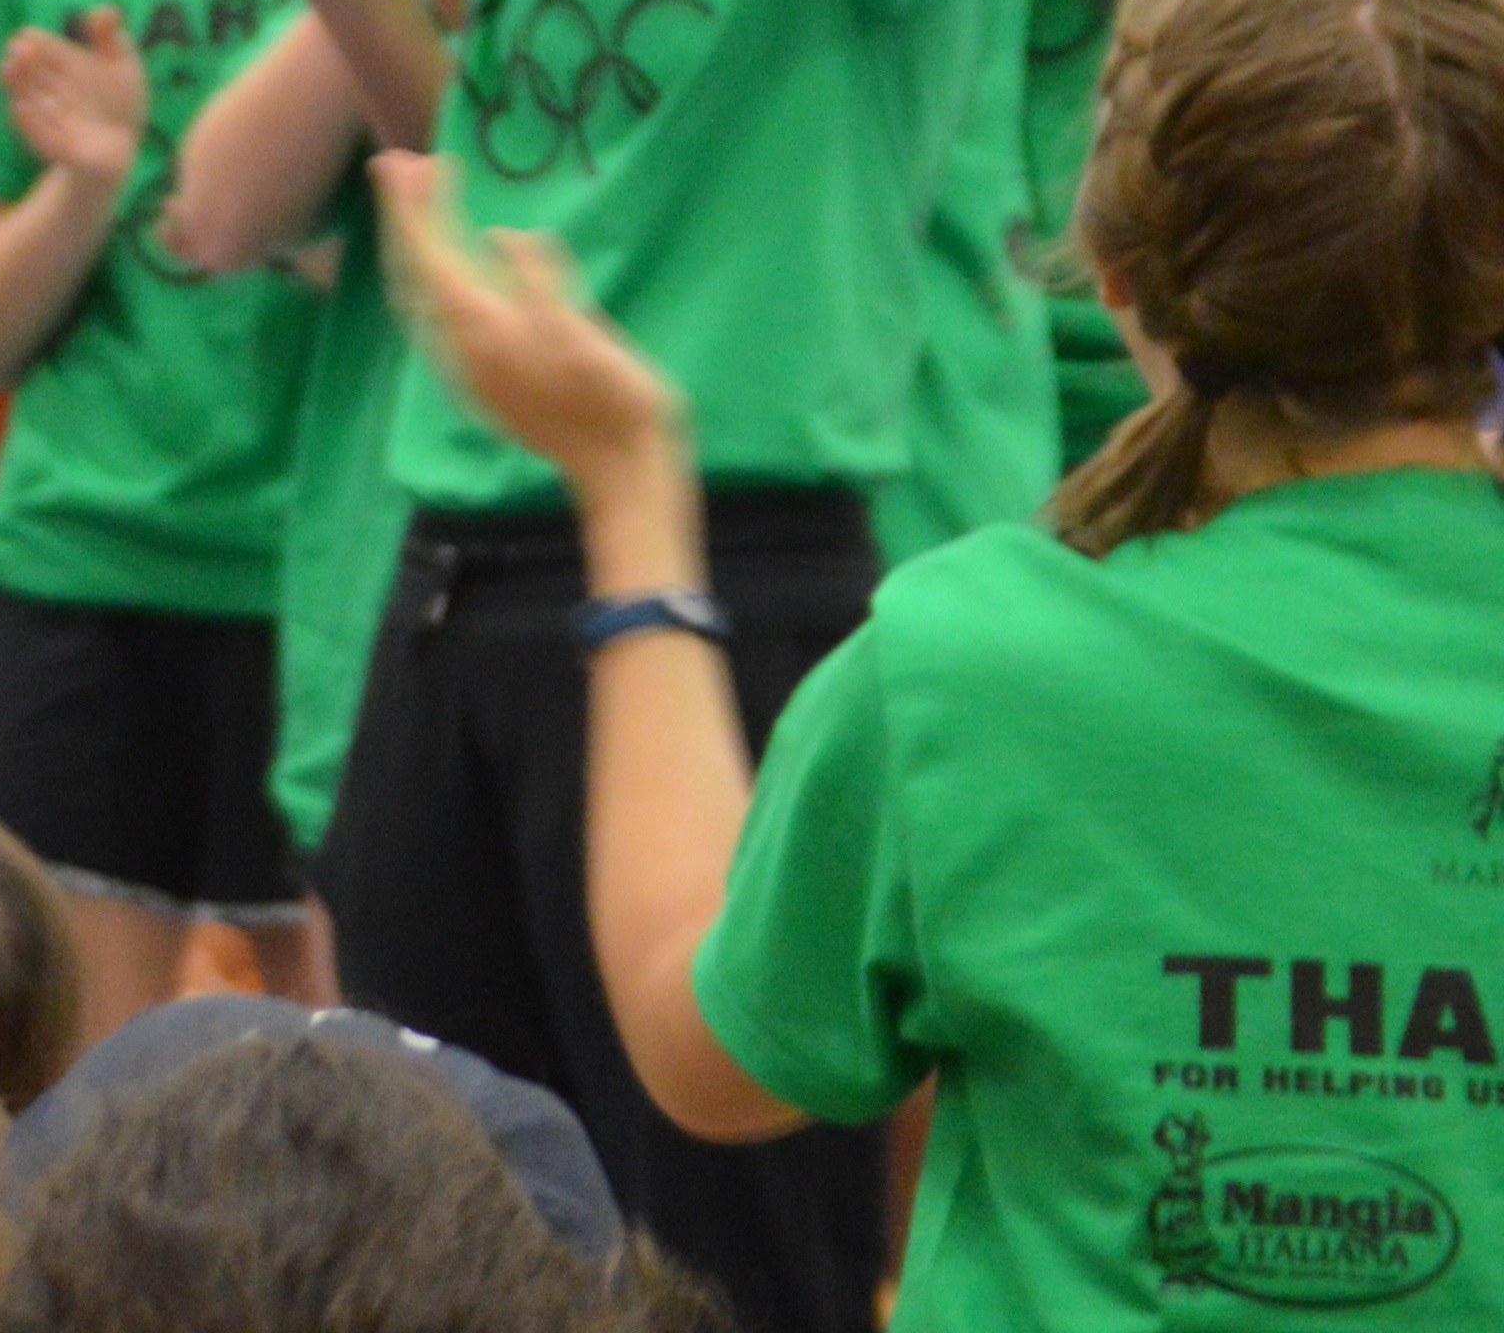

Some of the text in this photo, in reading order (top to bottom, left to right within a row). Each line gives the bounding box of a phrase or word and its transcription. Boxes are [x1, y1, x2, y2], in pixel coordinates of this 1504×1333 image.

[1163, 955, 1498, 1066] THA
[1153, 1062, 1240, 1091] FOR
[1263, 1066, 1447, 1102] HELPING
